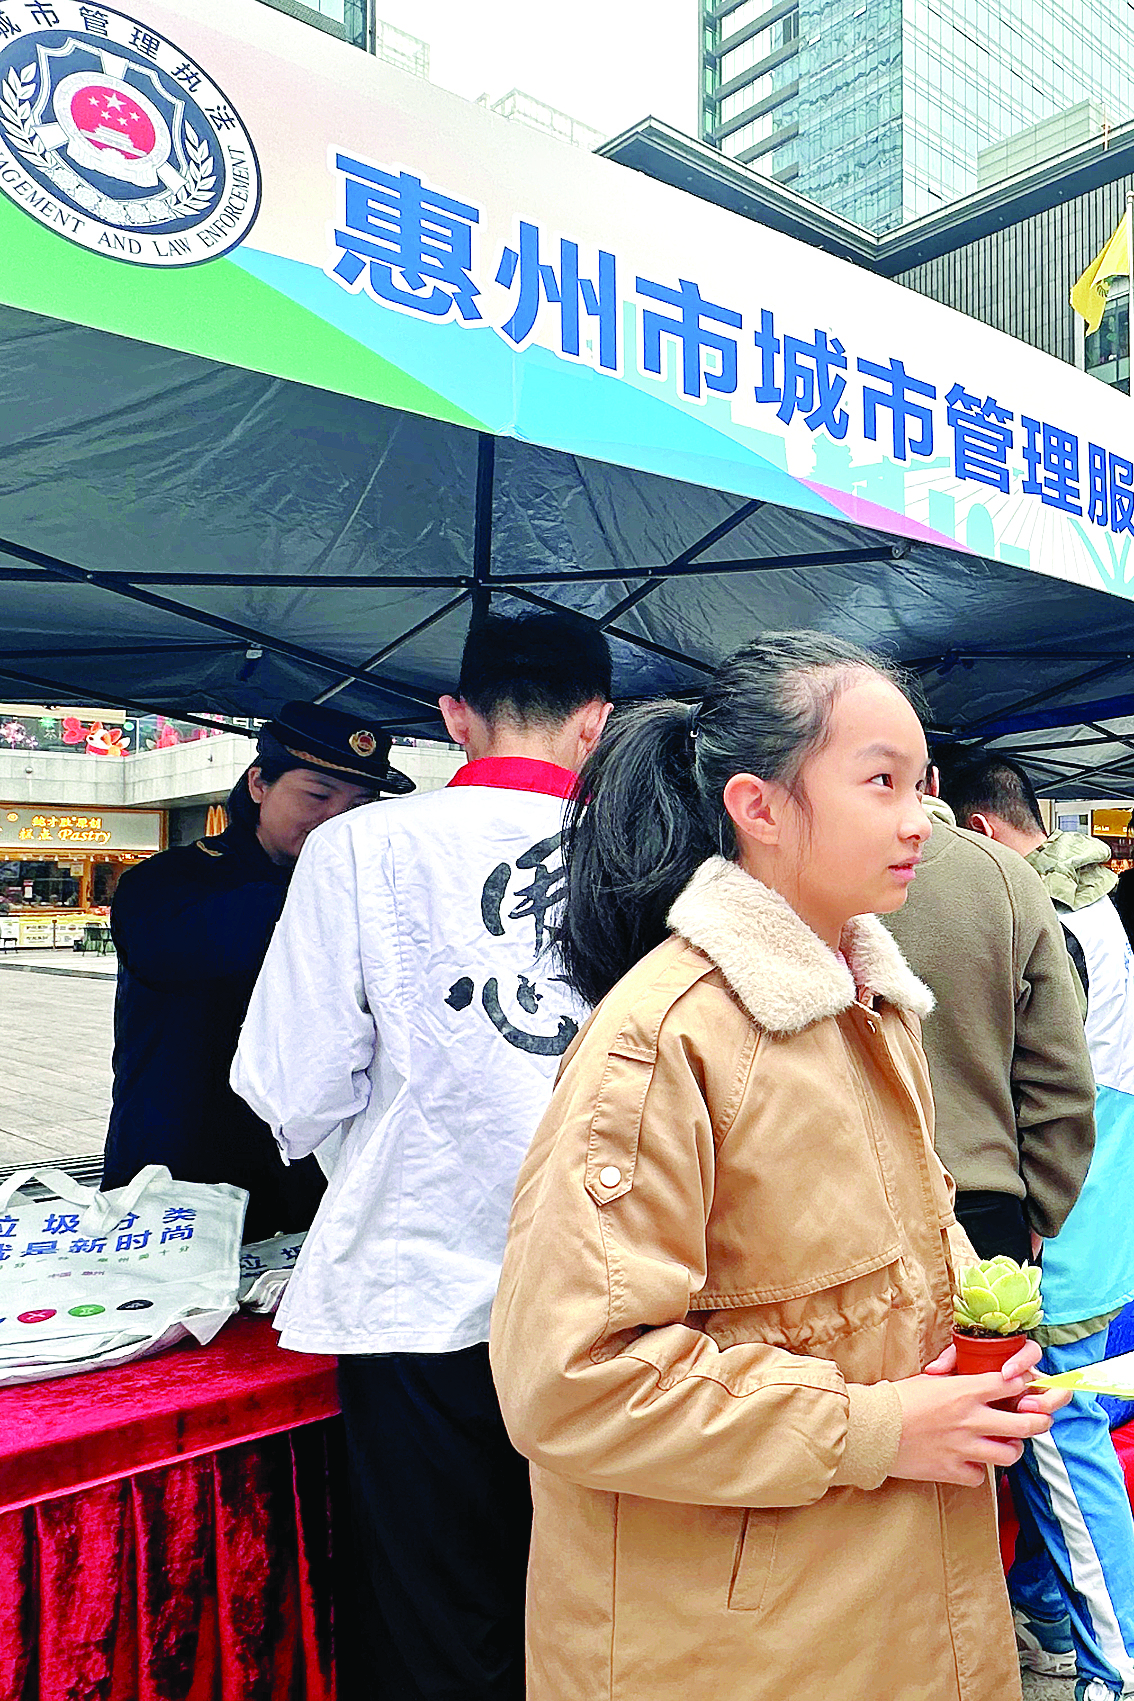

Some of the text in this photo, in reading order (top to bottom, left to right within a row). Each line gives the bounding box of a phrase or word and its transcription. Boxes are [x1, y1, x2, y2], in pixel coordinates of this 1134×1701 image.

[97, 231, 142, 254] AND
[152, 237, 192, 257] LAW
[196, 145, 250, 248] ENFORCEMENT
[58, 829, 111, 844] Pastry
